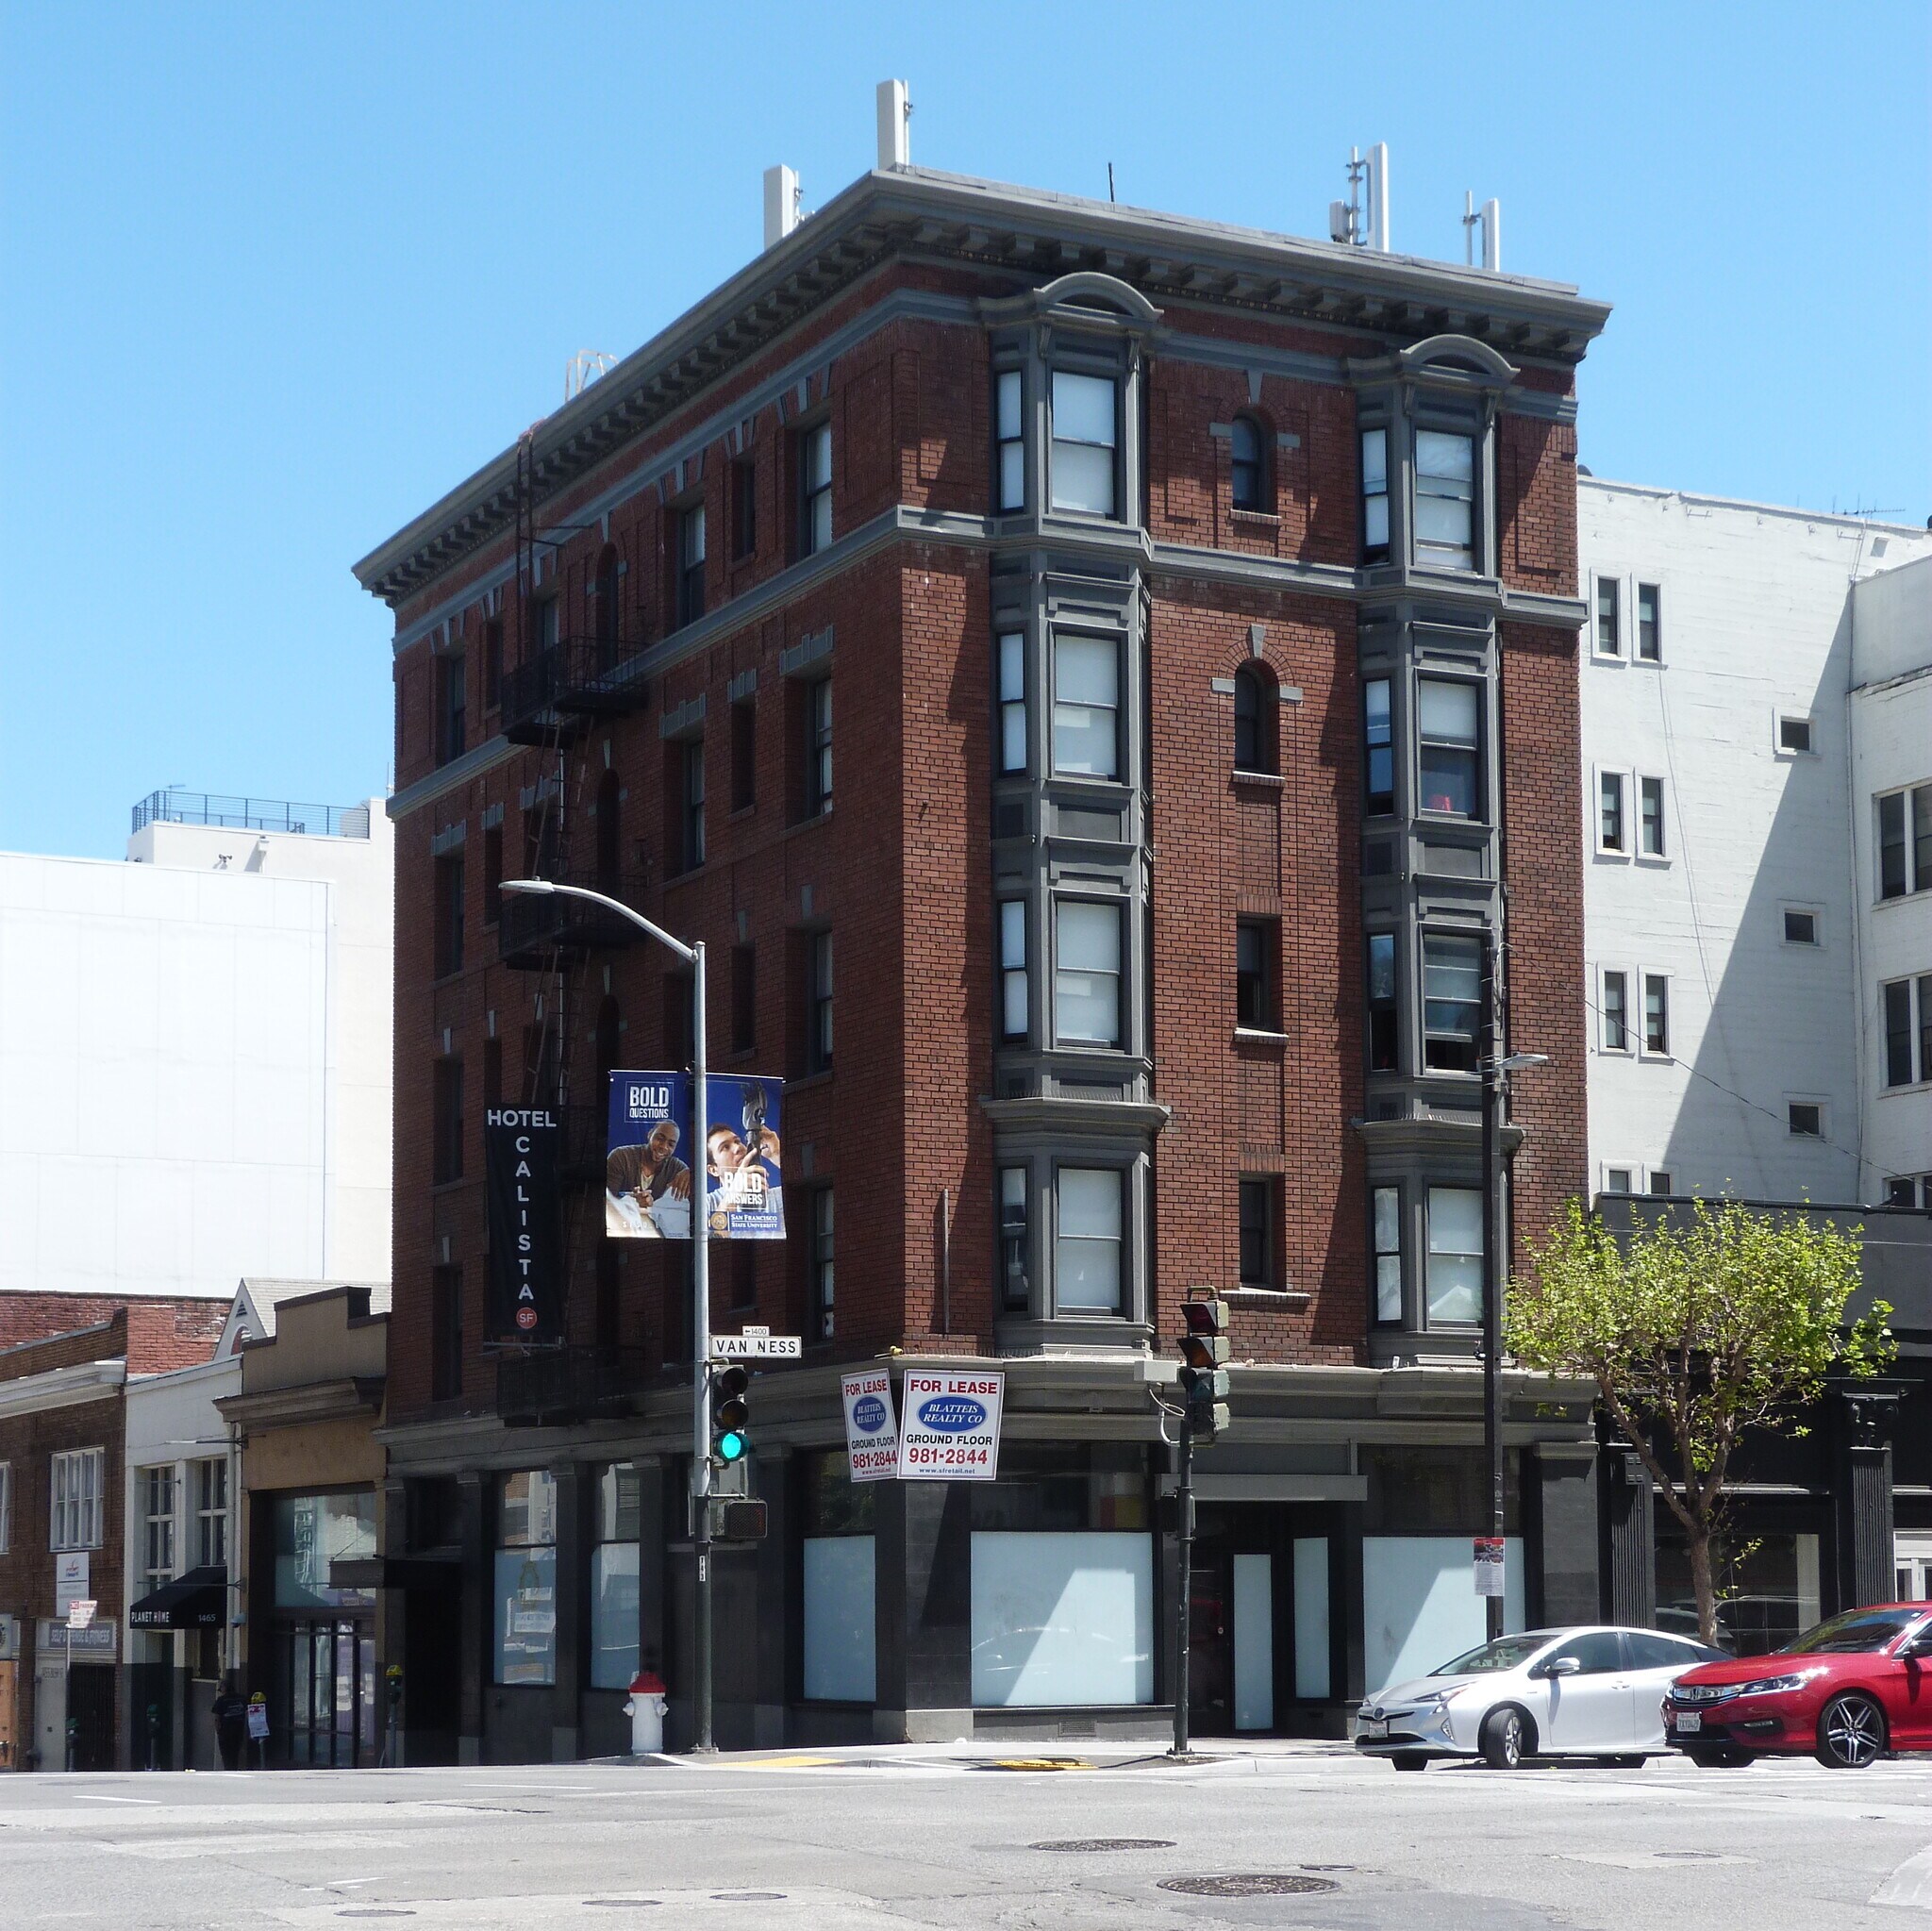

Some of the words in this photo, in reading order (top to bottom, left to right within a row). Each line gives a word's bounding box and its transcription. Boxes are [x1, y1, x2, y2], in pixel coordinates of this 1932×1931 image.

[629, 1086, 669, 1107] BOLD
[488, 1109, 557, 1127] HOTEL
[629, 1107, 669, 1119] QUESTIONS
[724, 1172, 762, 1193] BOLD
[724, 1192, 763, 1205] ANSWERS
[515, 1136, 534, 1300] CALISTA
[519, 1313, 534, 1323] SF
[716, 1340, 747, 1353] VAN
[758, 1340, 796, 1354] NESS
[845, 1383, 861, 1397] FOR
[862, 1378, 888, 1394] LEASE
[910, 1379, 941, 1392] FOR
[948, 1380, 998, 1394] LEASE
[858, 1403, 881, 1414] BLATTEIS
[928, 1404, 978, 1413] BLATTEIS
[857, 1414, 876, 1424] REALTY
[876, 1412, 885, 1422] CO
[923, 1414, 965, 1423] REALTY
[968, 1415, 983, 1423] CO
[851, 1439, 876, 1450] GROUND
[876, 1436, 895, 1448] FLOOR
[906, 1434, 953, 1444] GROUND
[957, 1435, 992, 1446] FLOOR
[852, 1450, 897, 1469] 981-2844
[908, 1447, 988, 1464] 981-2844
[131, 1611, 153, 1623] PLANET
[198, 1613, 216, 1622] 1465
